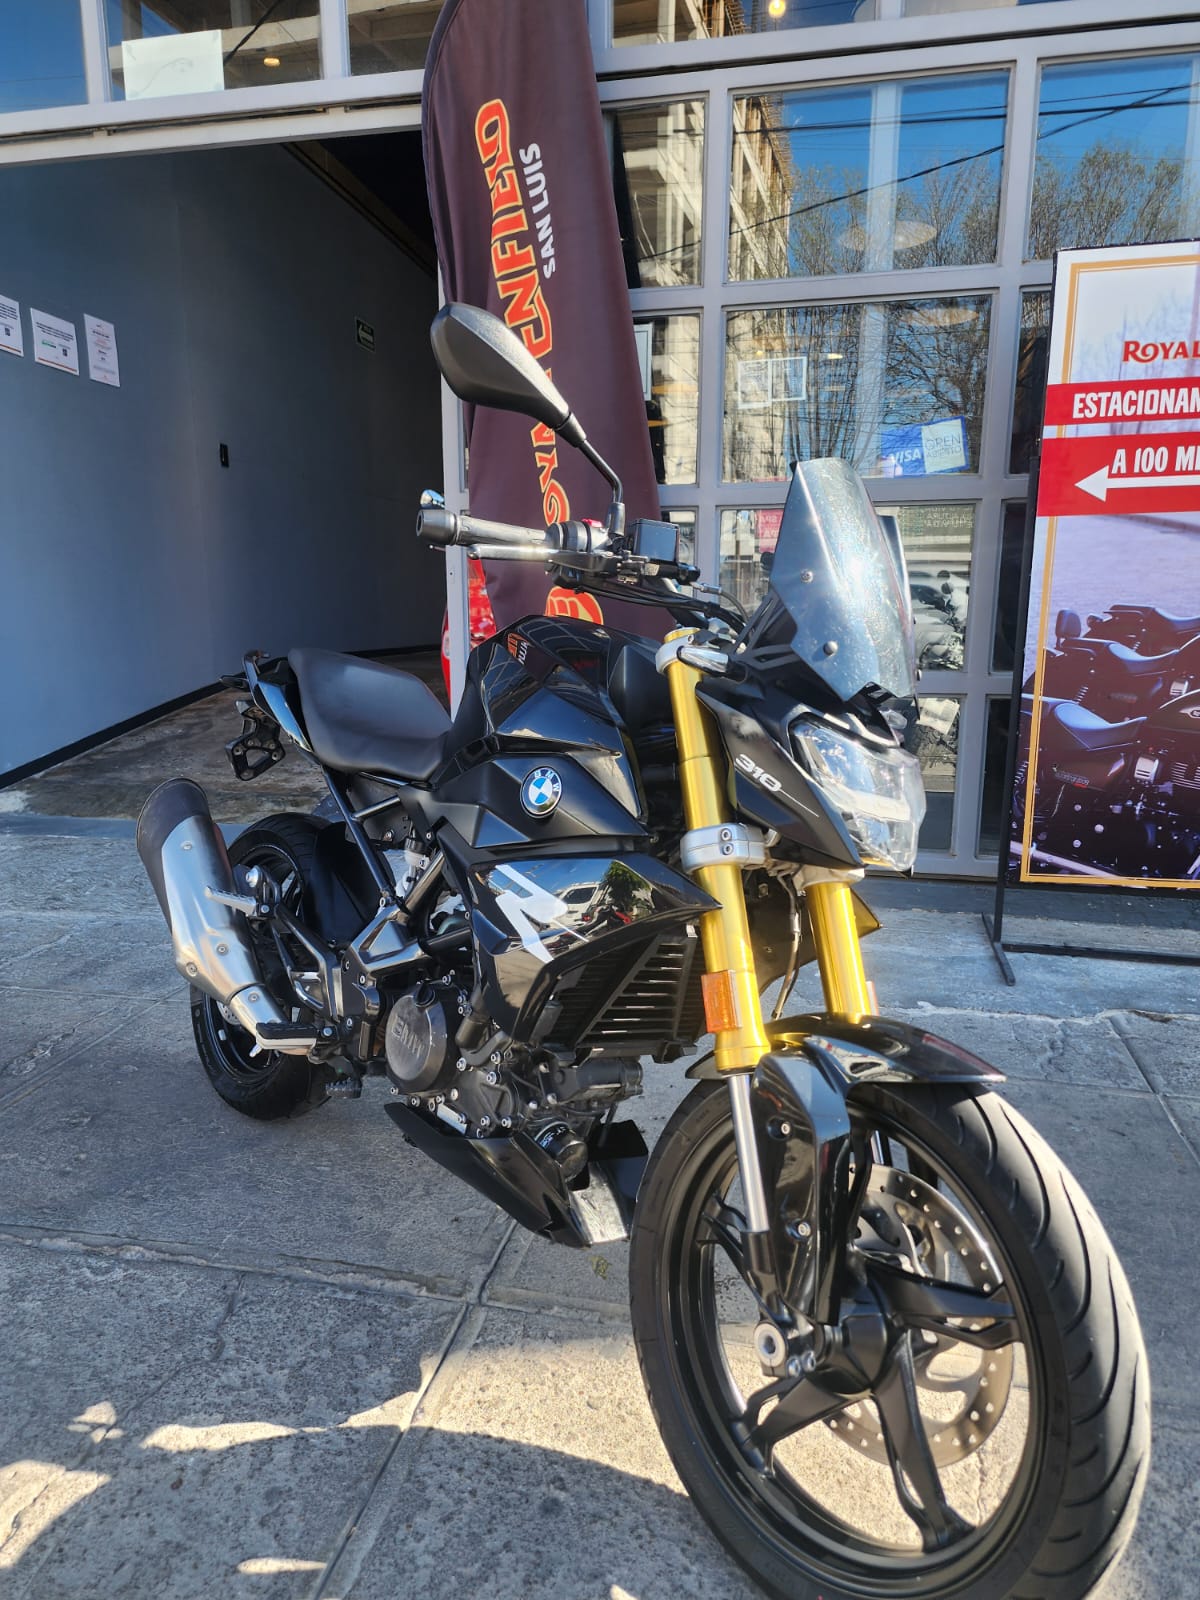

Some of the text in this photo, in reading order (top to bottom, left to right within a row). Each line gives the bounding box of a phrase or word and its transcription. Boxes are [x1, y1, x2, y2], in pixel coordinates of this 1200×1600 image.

[519, 143, 556, 279] SAN LUIS
[926, 433, 961, 450] OPEN
[1111, 448, 1127, 474] A
[1133, 446, 1168, 473] 100
[735, 753, 782, 792] 310
